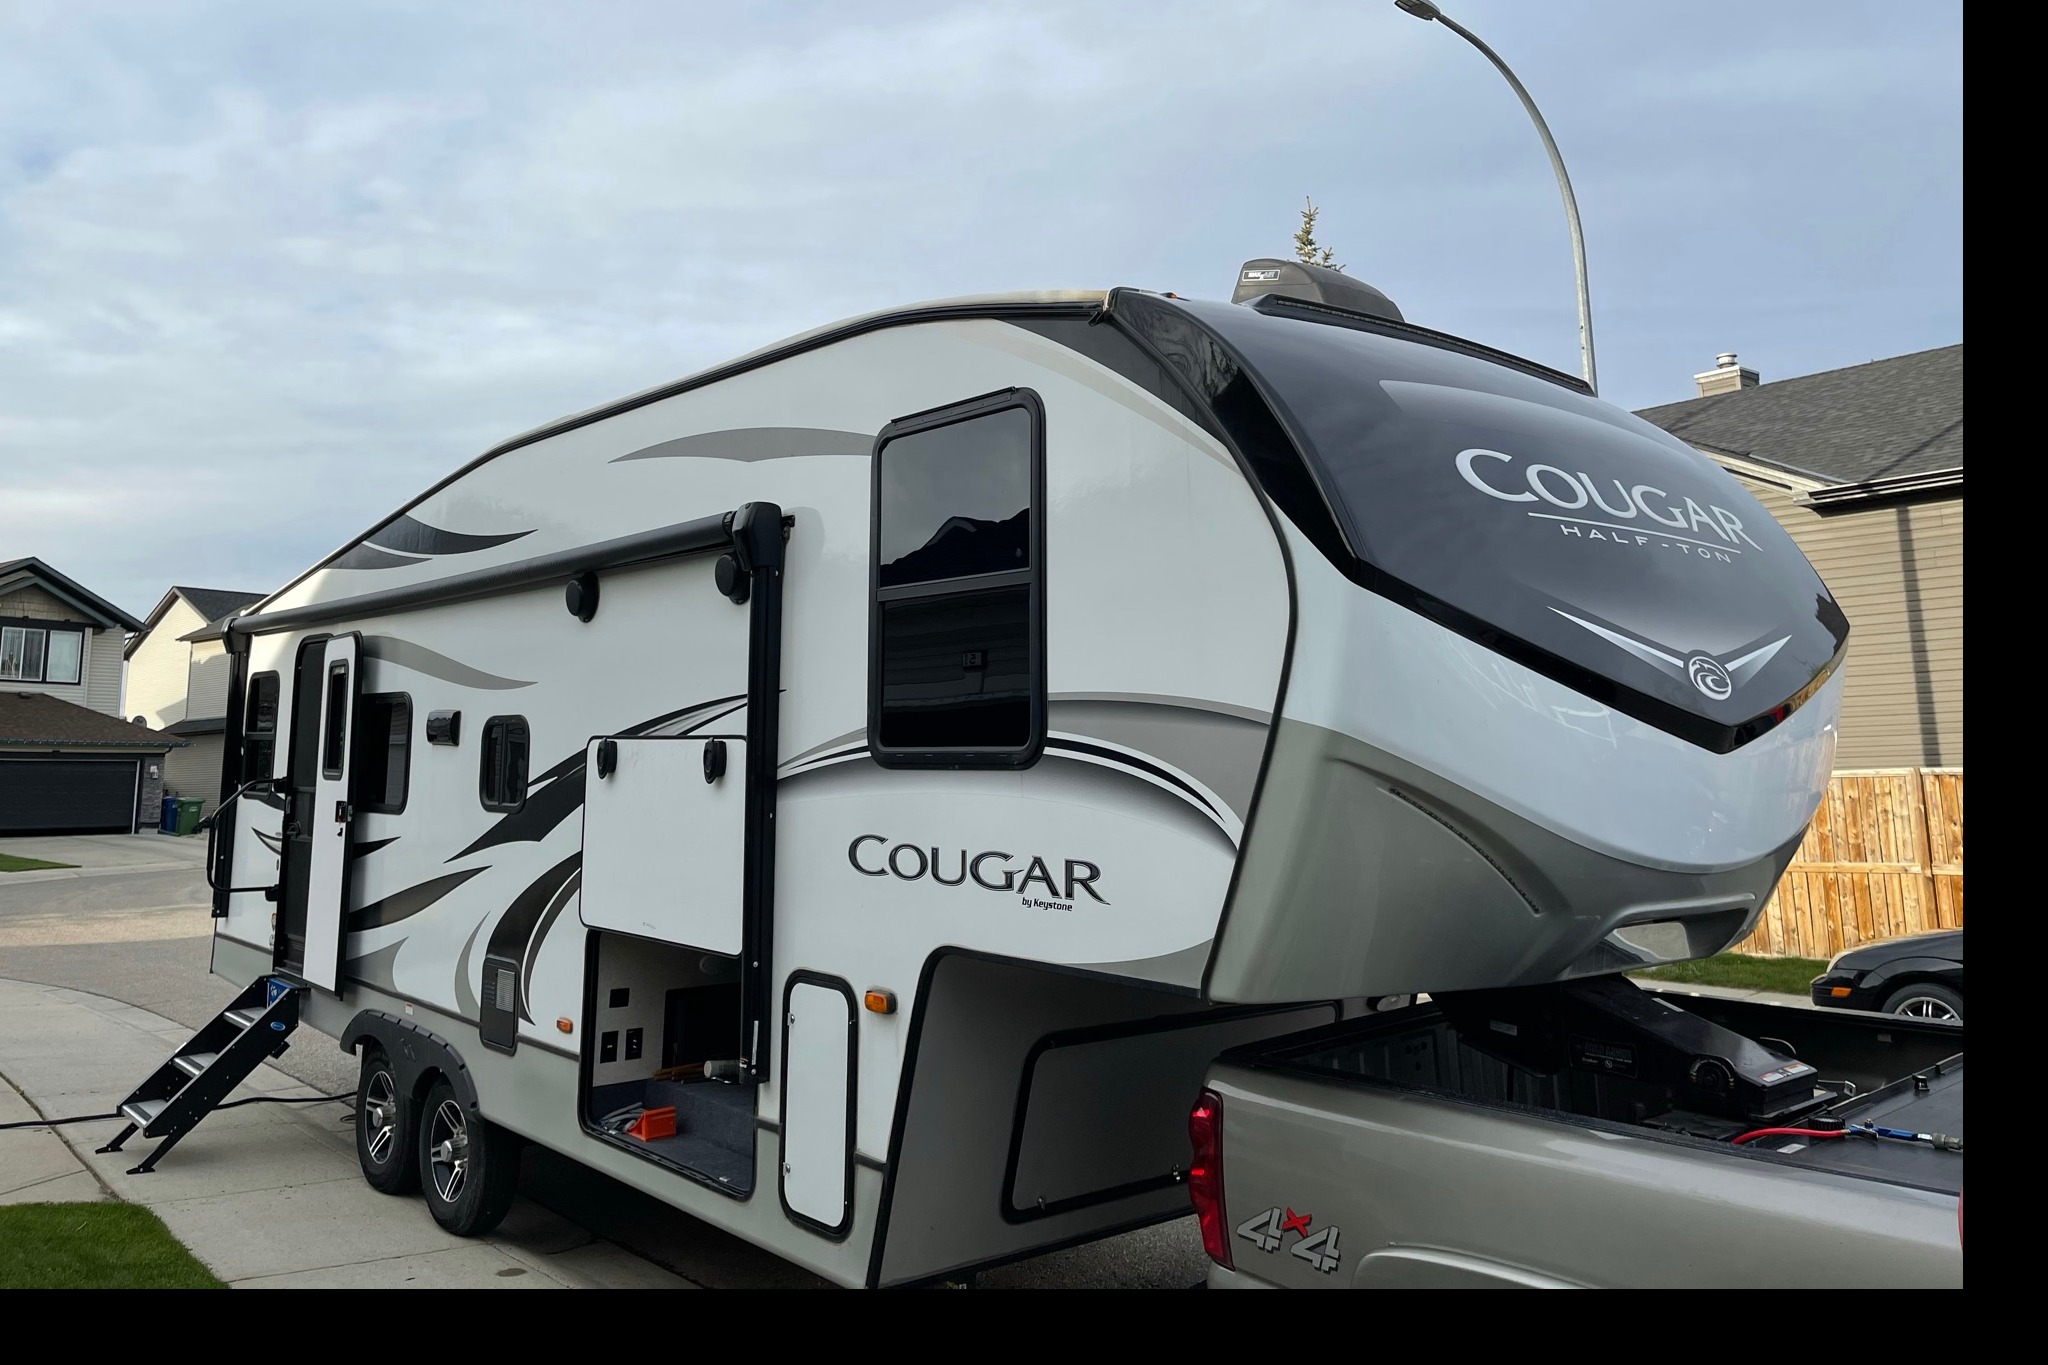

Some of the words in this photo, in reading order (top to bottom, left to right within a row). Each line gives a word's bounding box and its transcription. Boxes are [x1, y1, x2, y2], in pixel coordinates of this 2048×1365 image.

[1455, 448, 1763, 552] COUGAR
[1560, 524, 1732, 563] HALF-TON
[848, 834, 1111, 905] COUGAR
[1021, 897, 1032, 908] by
[1033, 898, 1073, 911] Keystone
